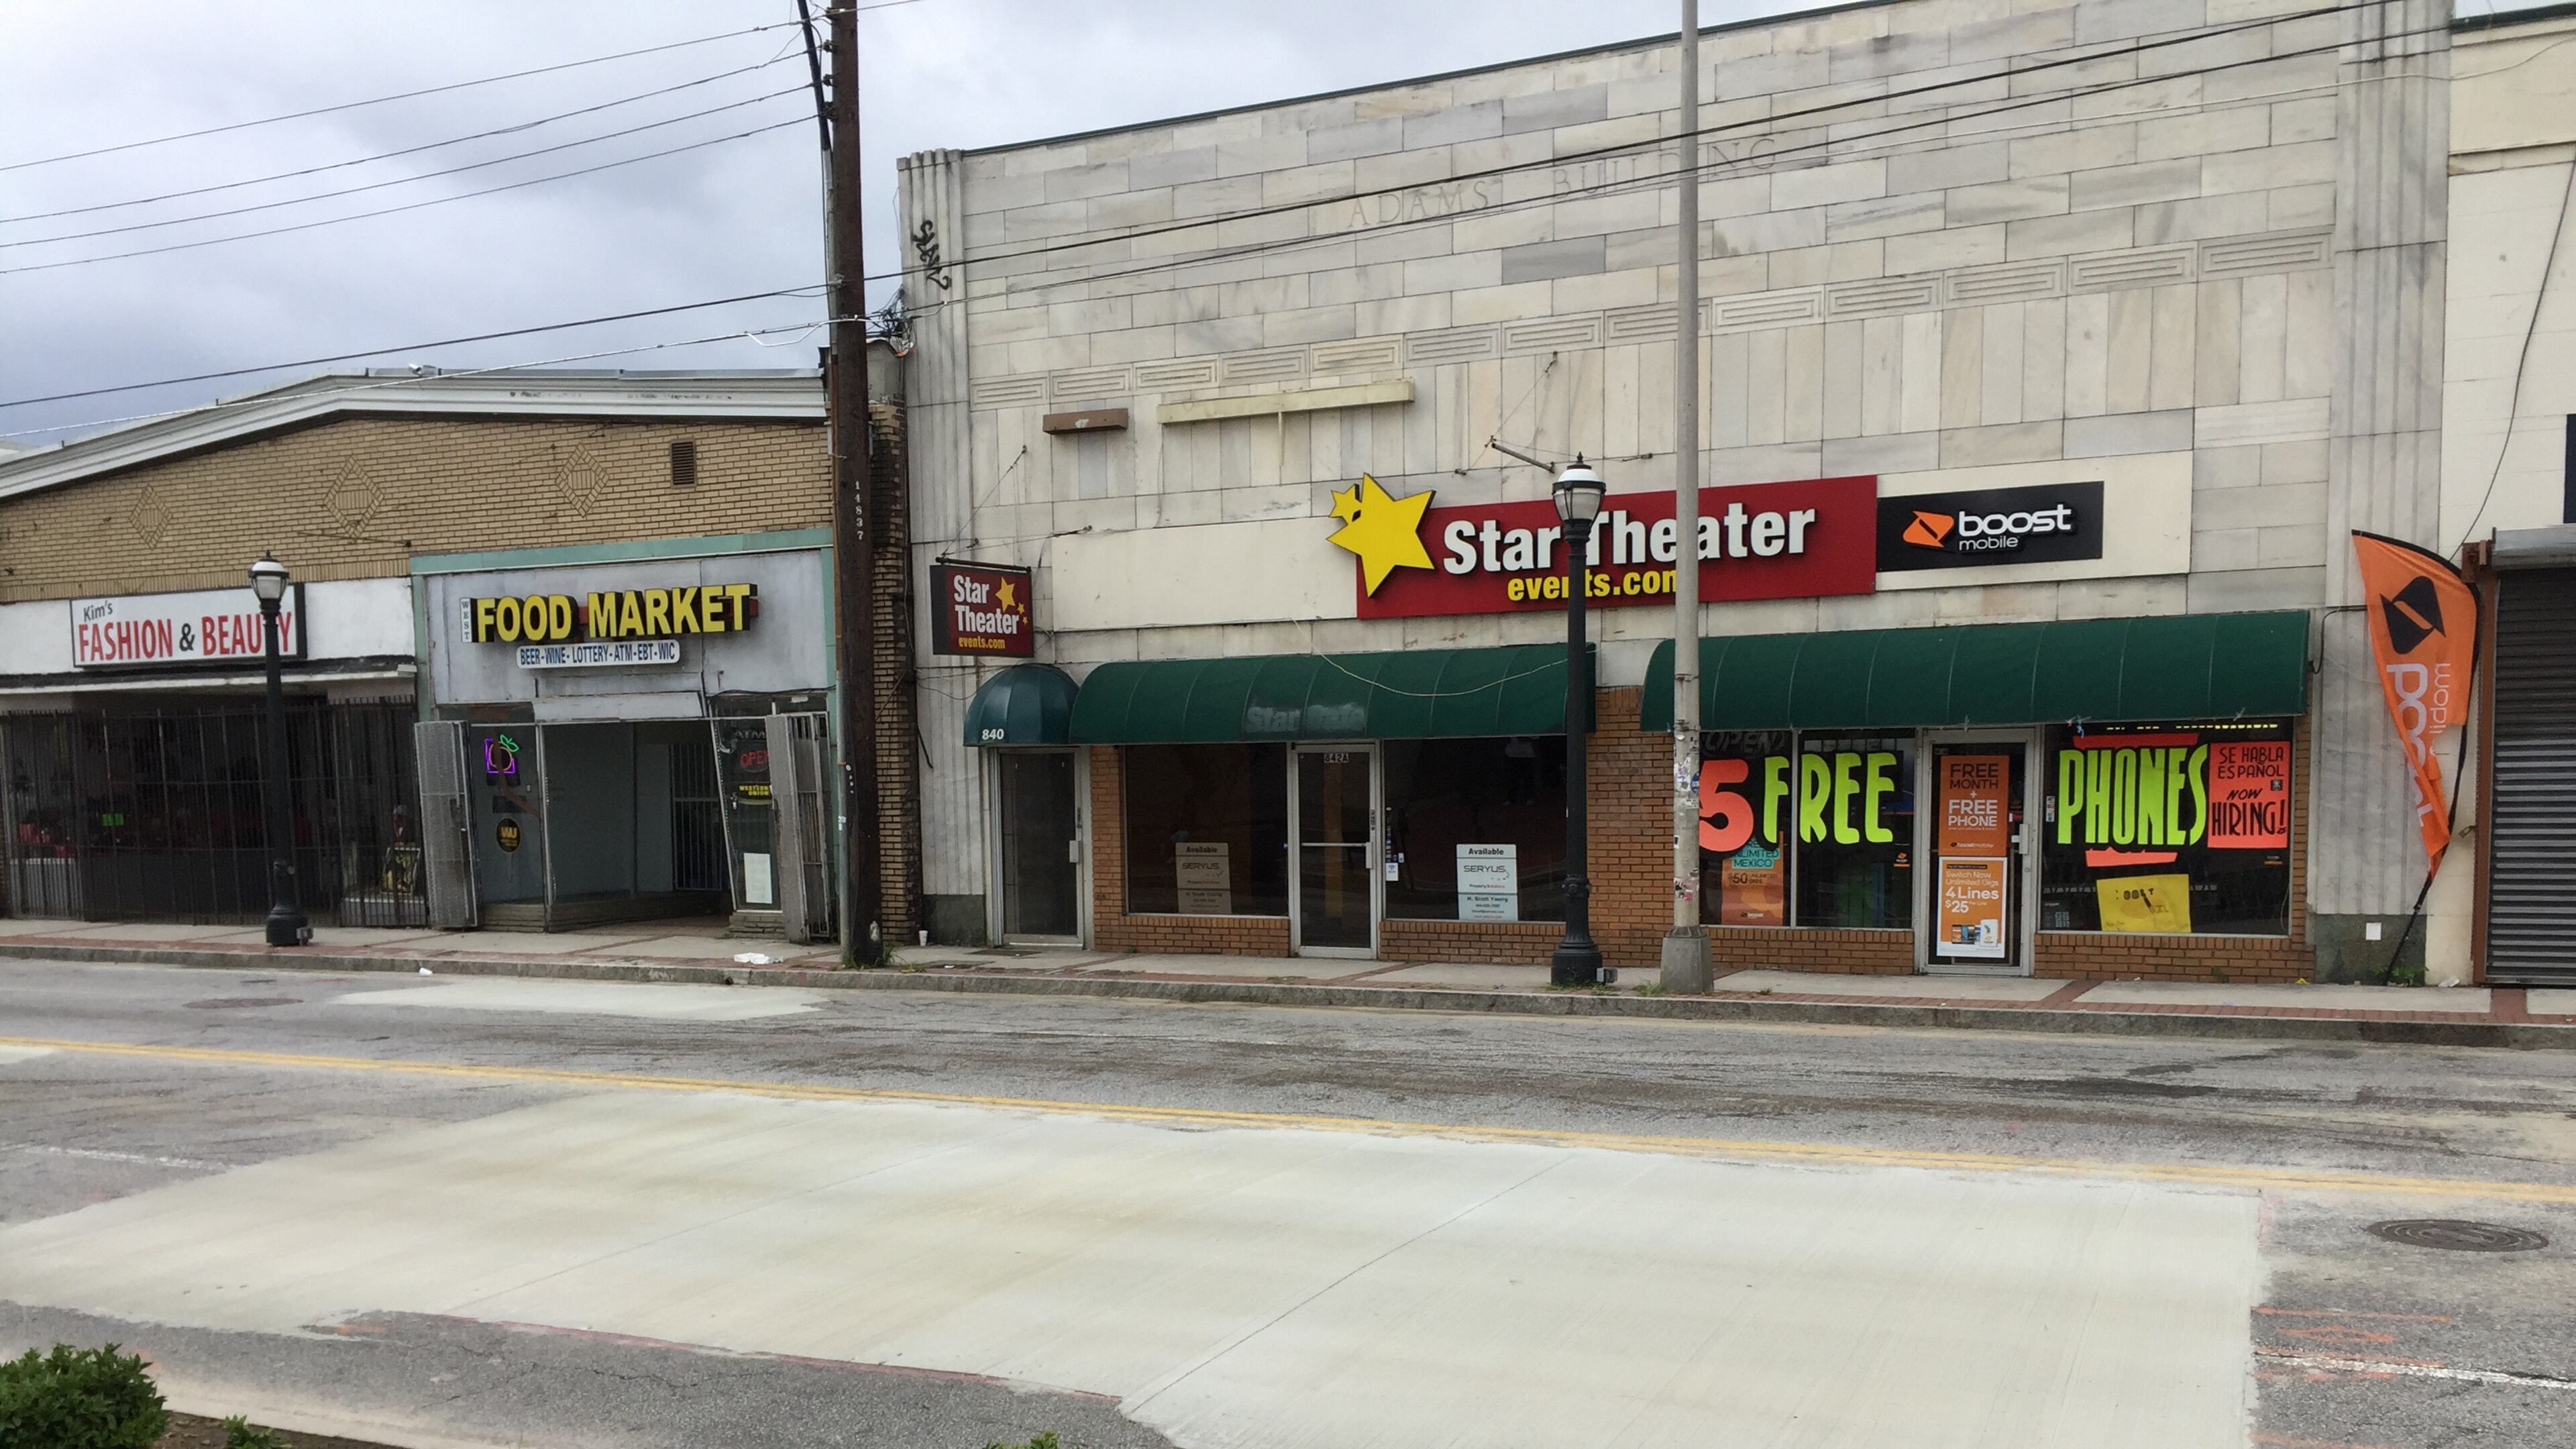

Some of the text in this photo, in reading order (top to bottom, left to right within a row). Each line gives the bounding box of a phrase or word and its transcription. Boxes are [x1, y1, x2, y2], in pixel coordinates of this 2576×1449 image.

[1347, 138, 1775, 228] ADAMS BUILDNG
[1958, 504, 2072, 537] boost
[1443, 502, 1815, 574] Star Theater
[1959, 537, 2019, 551] mobile
[953, 574, 989, 604] Star
[83, 600, 113, 623] Kim's
[462, 601, 471, 640] WEST
[476, 584, 751, 643] FOOD MARKET
[955, 604, 1020, 635] Theater
[78, 611, 292, 661] FASHION & BEAUY
[959, 636, 1006, 649] events.com
[981, 729, 1004, 740] 840
[2219, 746, 2284, 764] SE HABLA
[1950, 763, 1998, 778] FREE
[2218, 762, 2284, 779] ESPAÑOL
[1949, 779, 1998, 789] MONTH
[1763, 752, 1896, 845] FREE
[2057, 743, 2208, 845] PHONES
[2226, 788, 2263, 800] NOW
[1949, 799, 1998, 814] FREE
[1948, 815, 1998, 826] PHONE
[2212, 799, 2286, 837] HIRING!
[1733, 859, 1772, 867] MEXICO
[1945, 886, 1999, 899] 4 Lines
